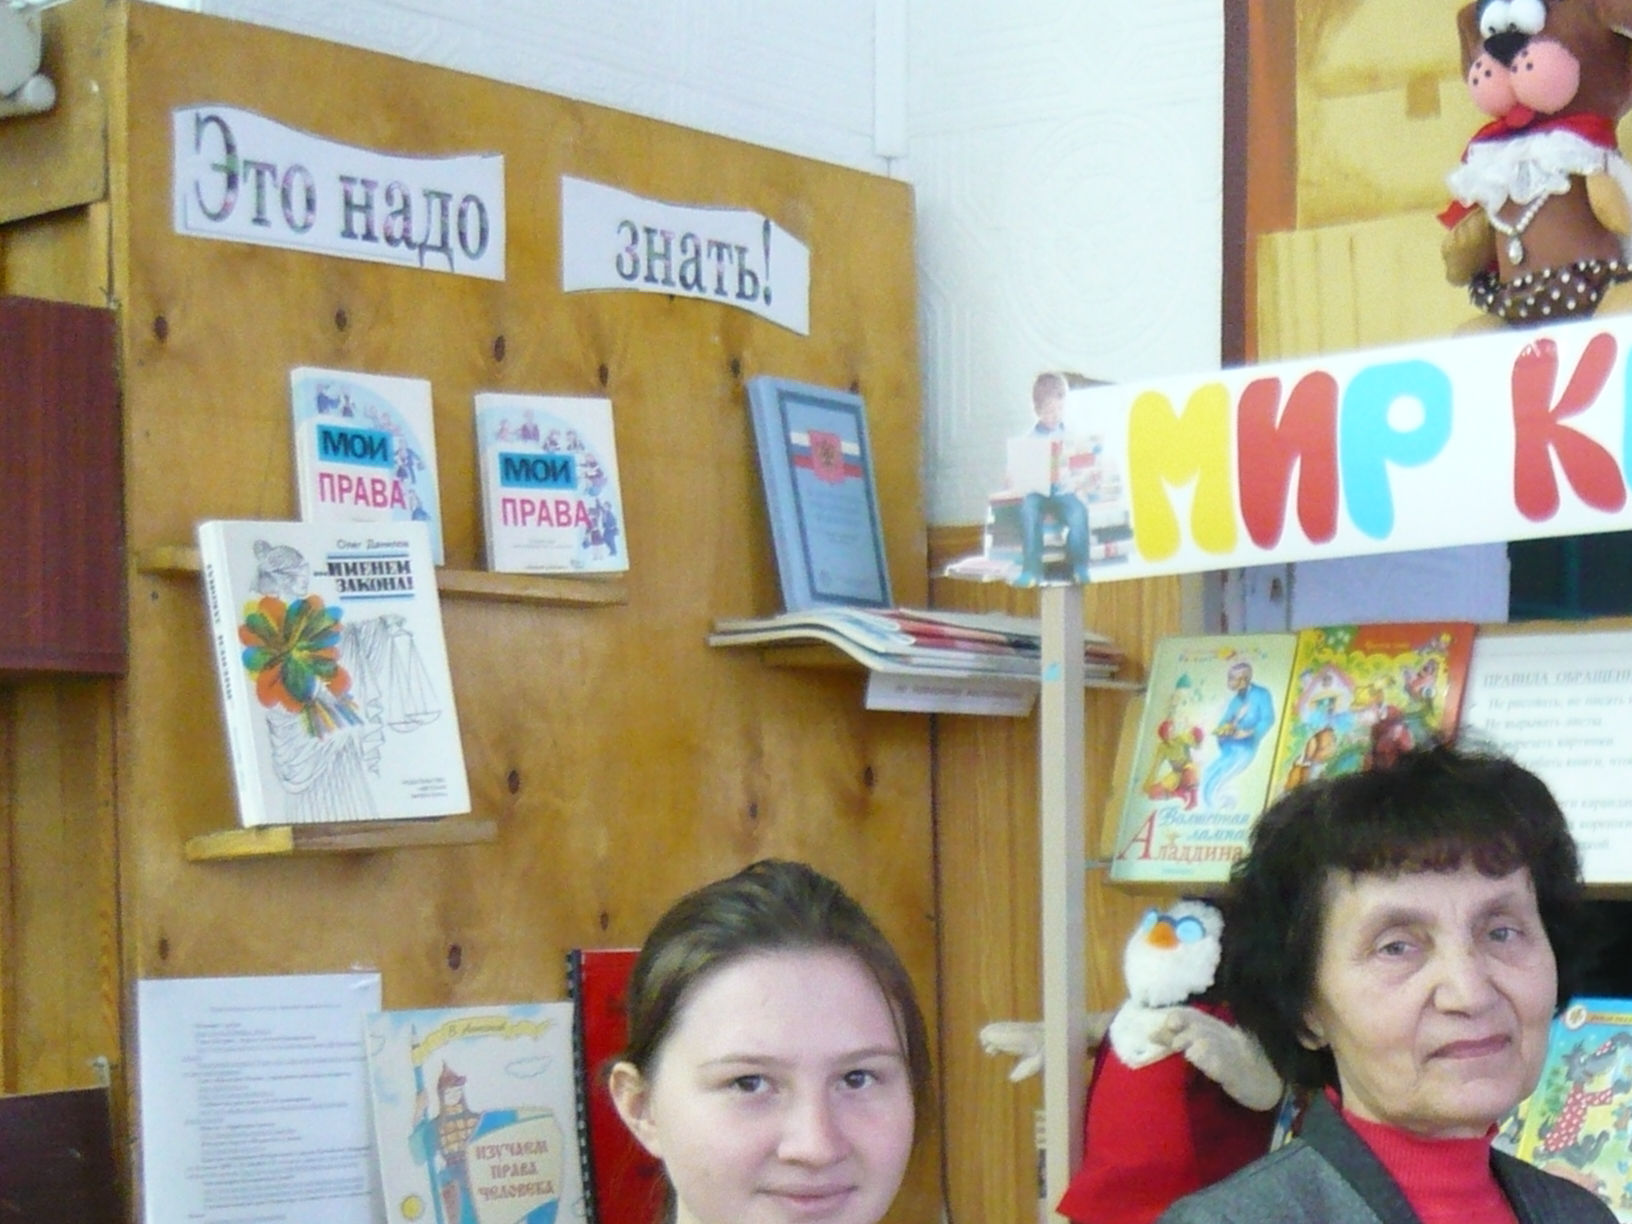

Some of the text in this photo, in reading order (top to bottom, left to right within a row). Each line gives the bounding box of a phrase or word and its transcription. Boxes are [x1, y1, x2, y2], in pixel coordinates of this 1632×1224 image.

[193, 111, 490, 273] Это надо
[615, 218, 773, 306] знать!
[322, 430, 389, 462] МОИ
[1126, 357, 1454, 562] МИР
[503, 457, 572, 484] МОИ
[319, 472, 408, 510] ПРАВА
[501, 497, 594, 529] ПРАВА
[336, 577, 415, 593] ЗАКОНА!
[1483, 671, 1549, 687] ПРАВИЛА
[1117, 810, 1244, 863] Аладдина
[490, 1163, 538, 1180] ПРАВА
[477, 1180, 555, 1201] ЧЕЛОВЕКА
